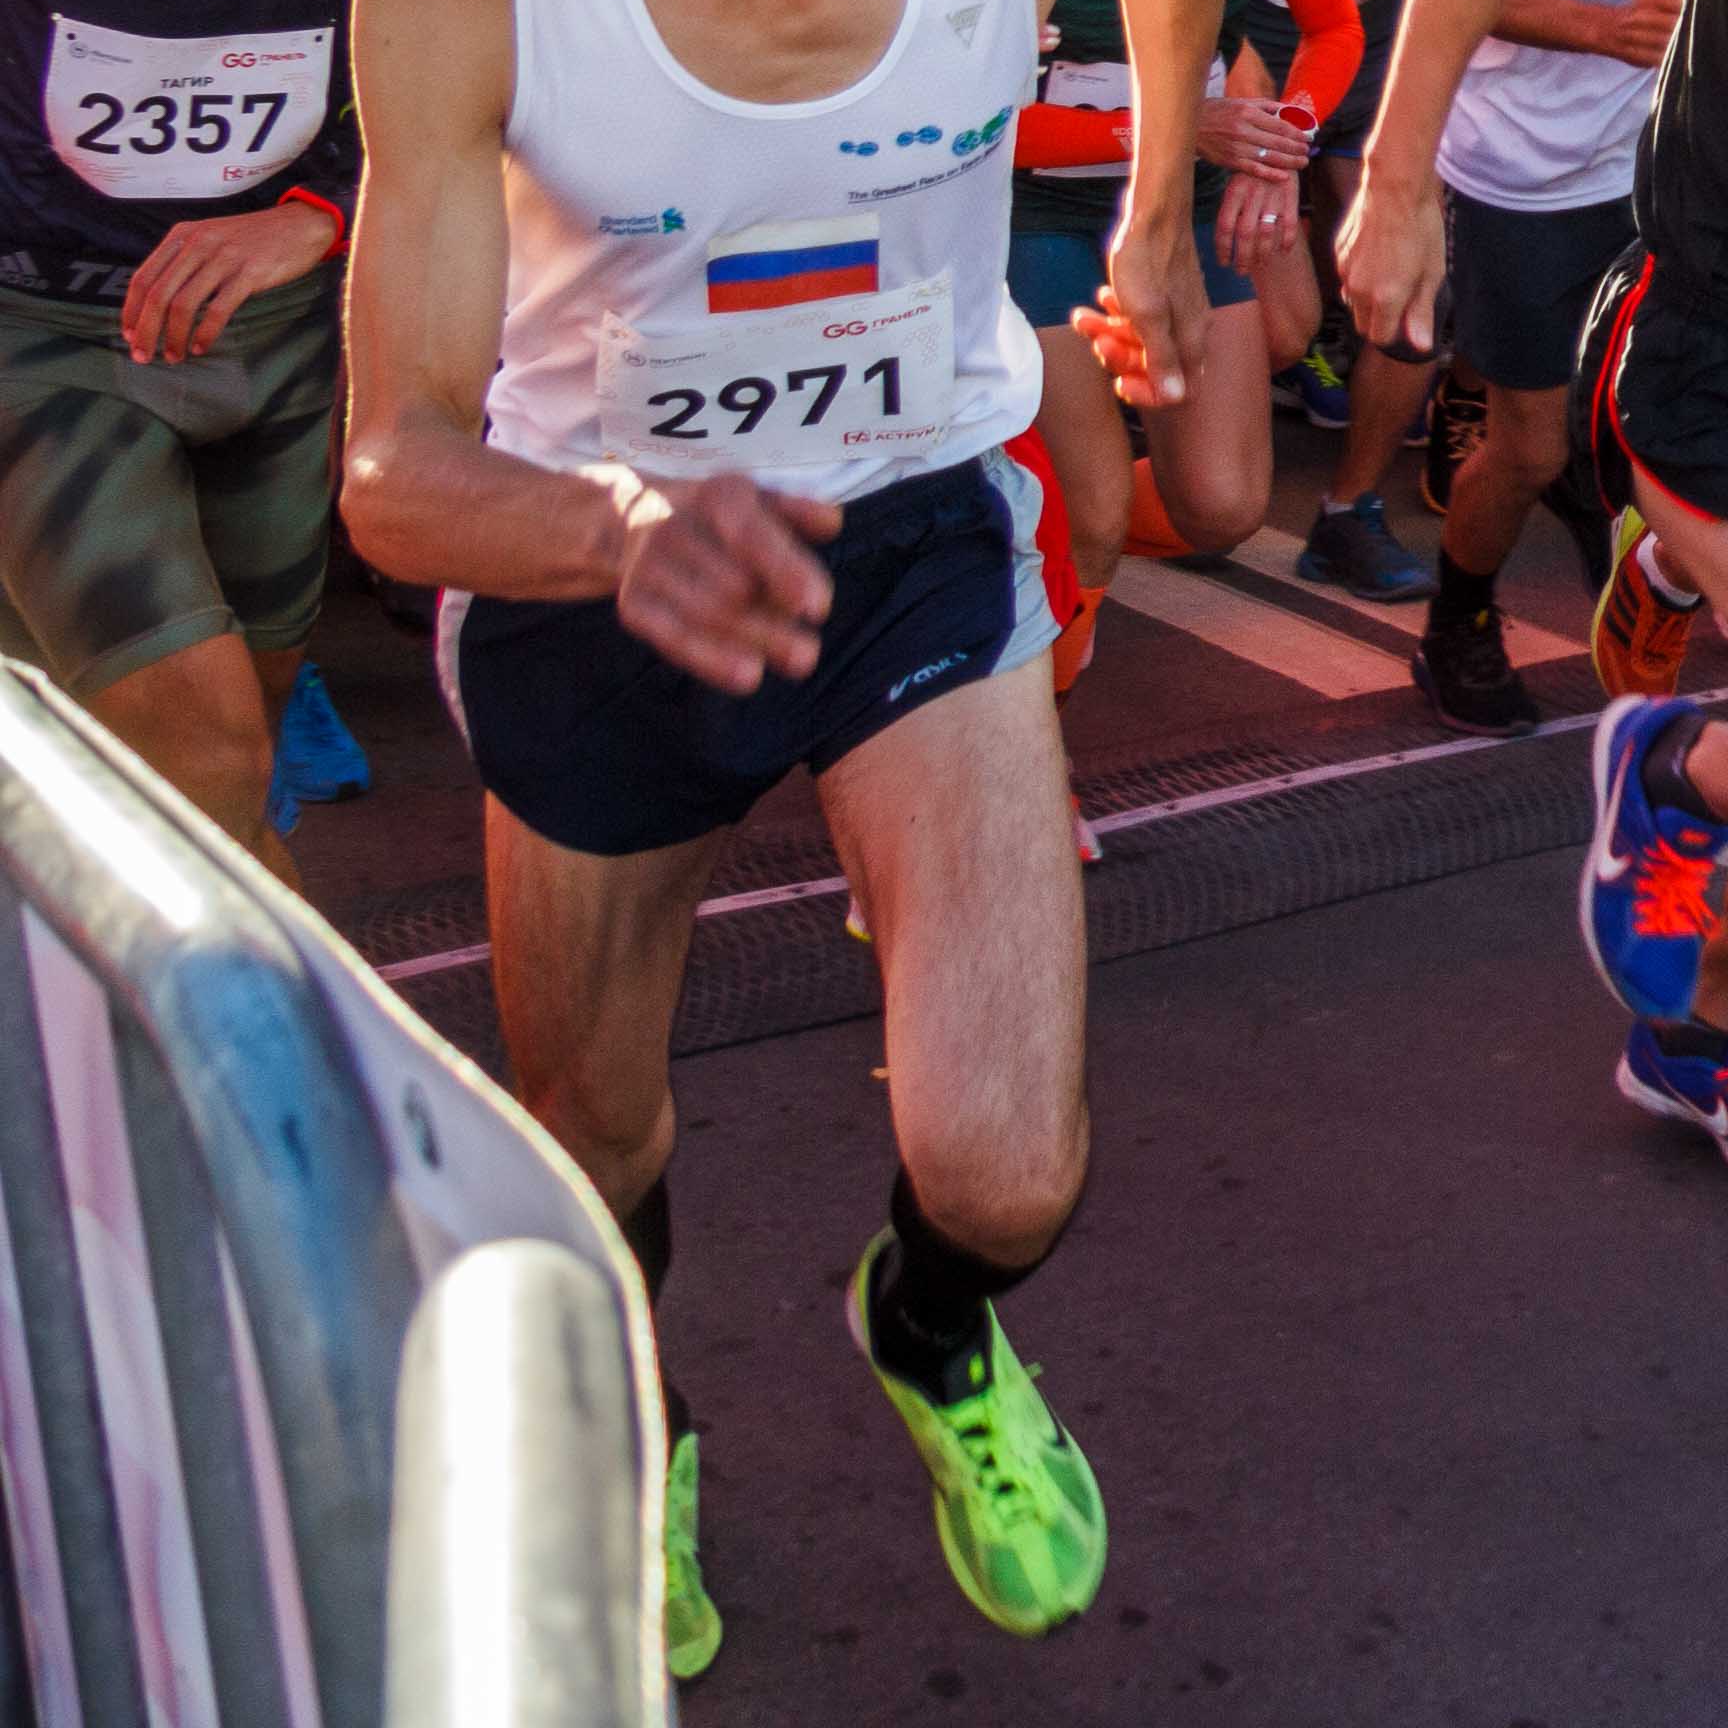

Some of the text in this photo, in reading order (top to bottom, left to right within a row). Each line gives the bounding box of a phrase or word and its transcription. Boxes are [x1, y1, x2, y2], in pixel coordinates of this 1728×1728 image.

[160, 76, 215, 89] ТАГИР
[75, 92, 289, 155] 2357
[823, 320, 868, 340] GG
[647, 356, 901, 439] 2971
